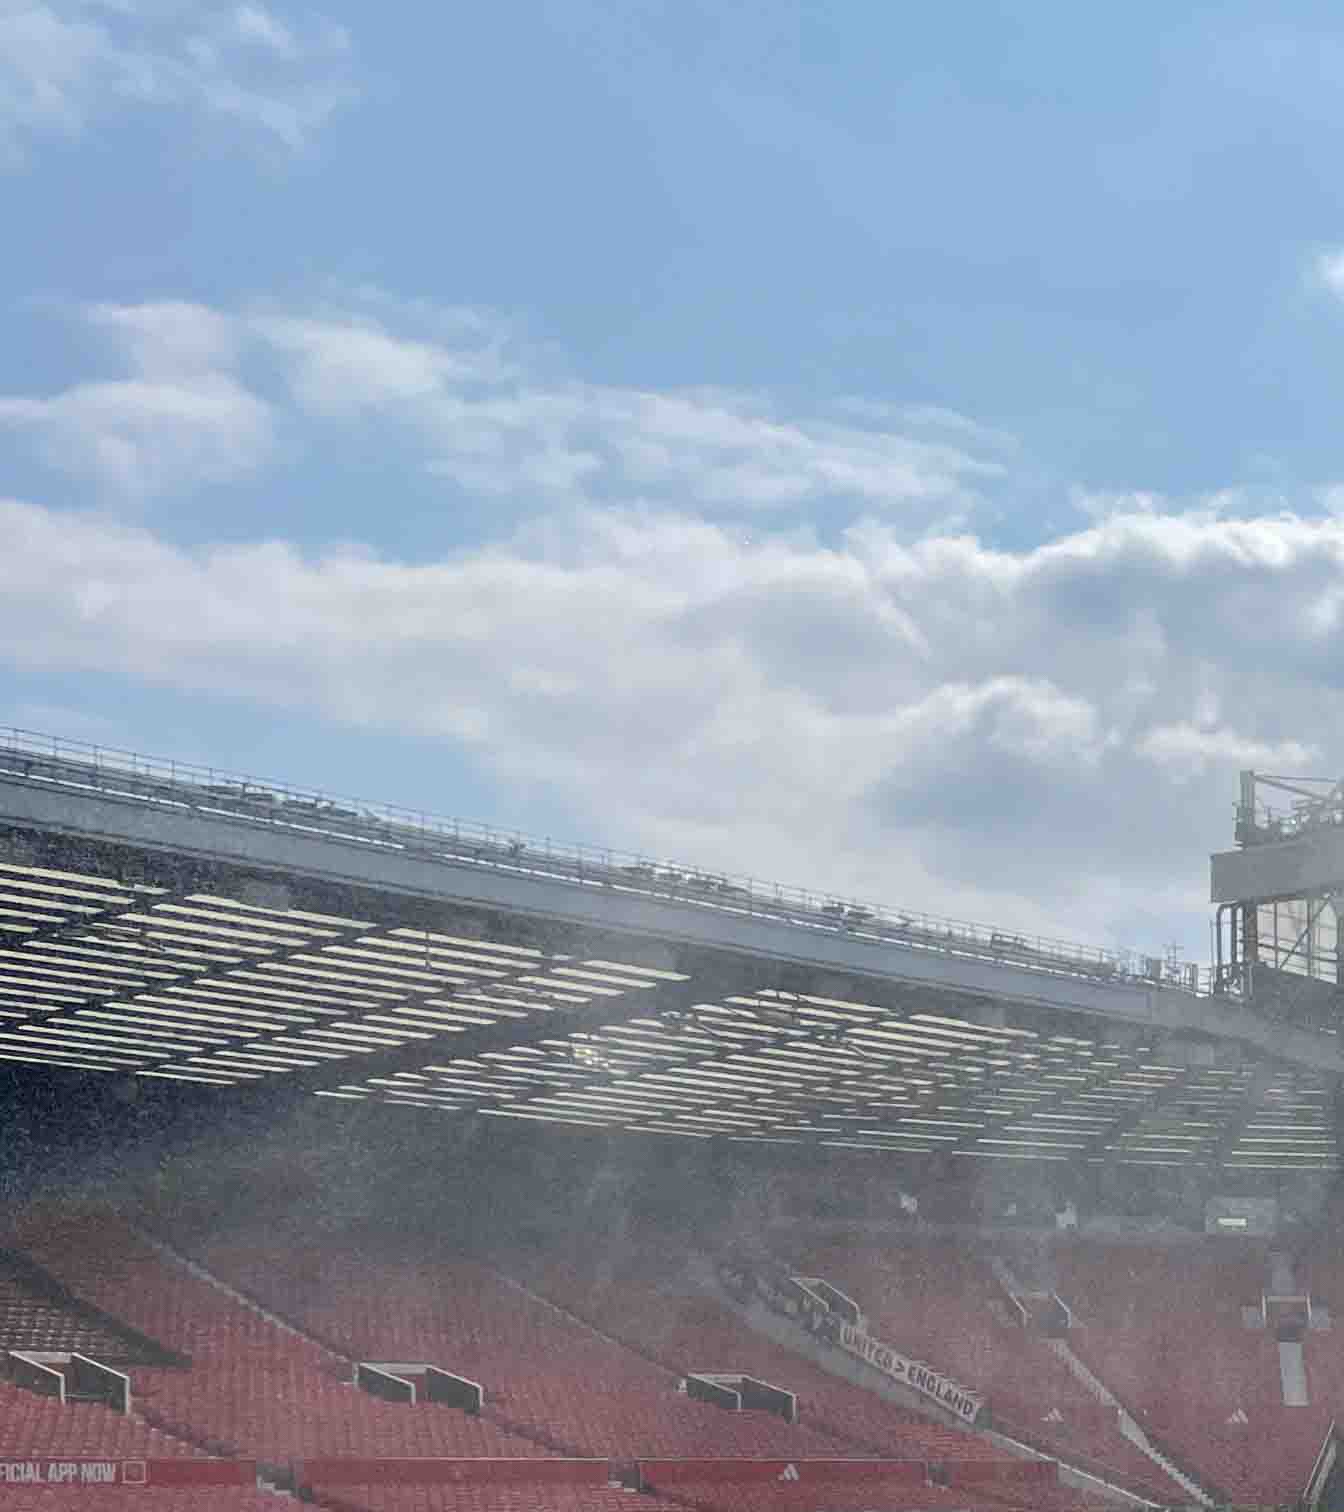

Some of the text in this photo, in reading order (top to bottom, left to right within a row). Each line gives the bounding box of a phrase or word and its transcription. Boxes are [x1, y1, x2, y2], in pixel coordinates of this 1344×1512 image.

[908, 1364, 974, 1417] ENGLAND
[48, 1463, 77, 1482] APP
[81, 1463, 117, 1483] NOW
